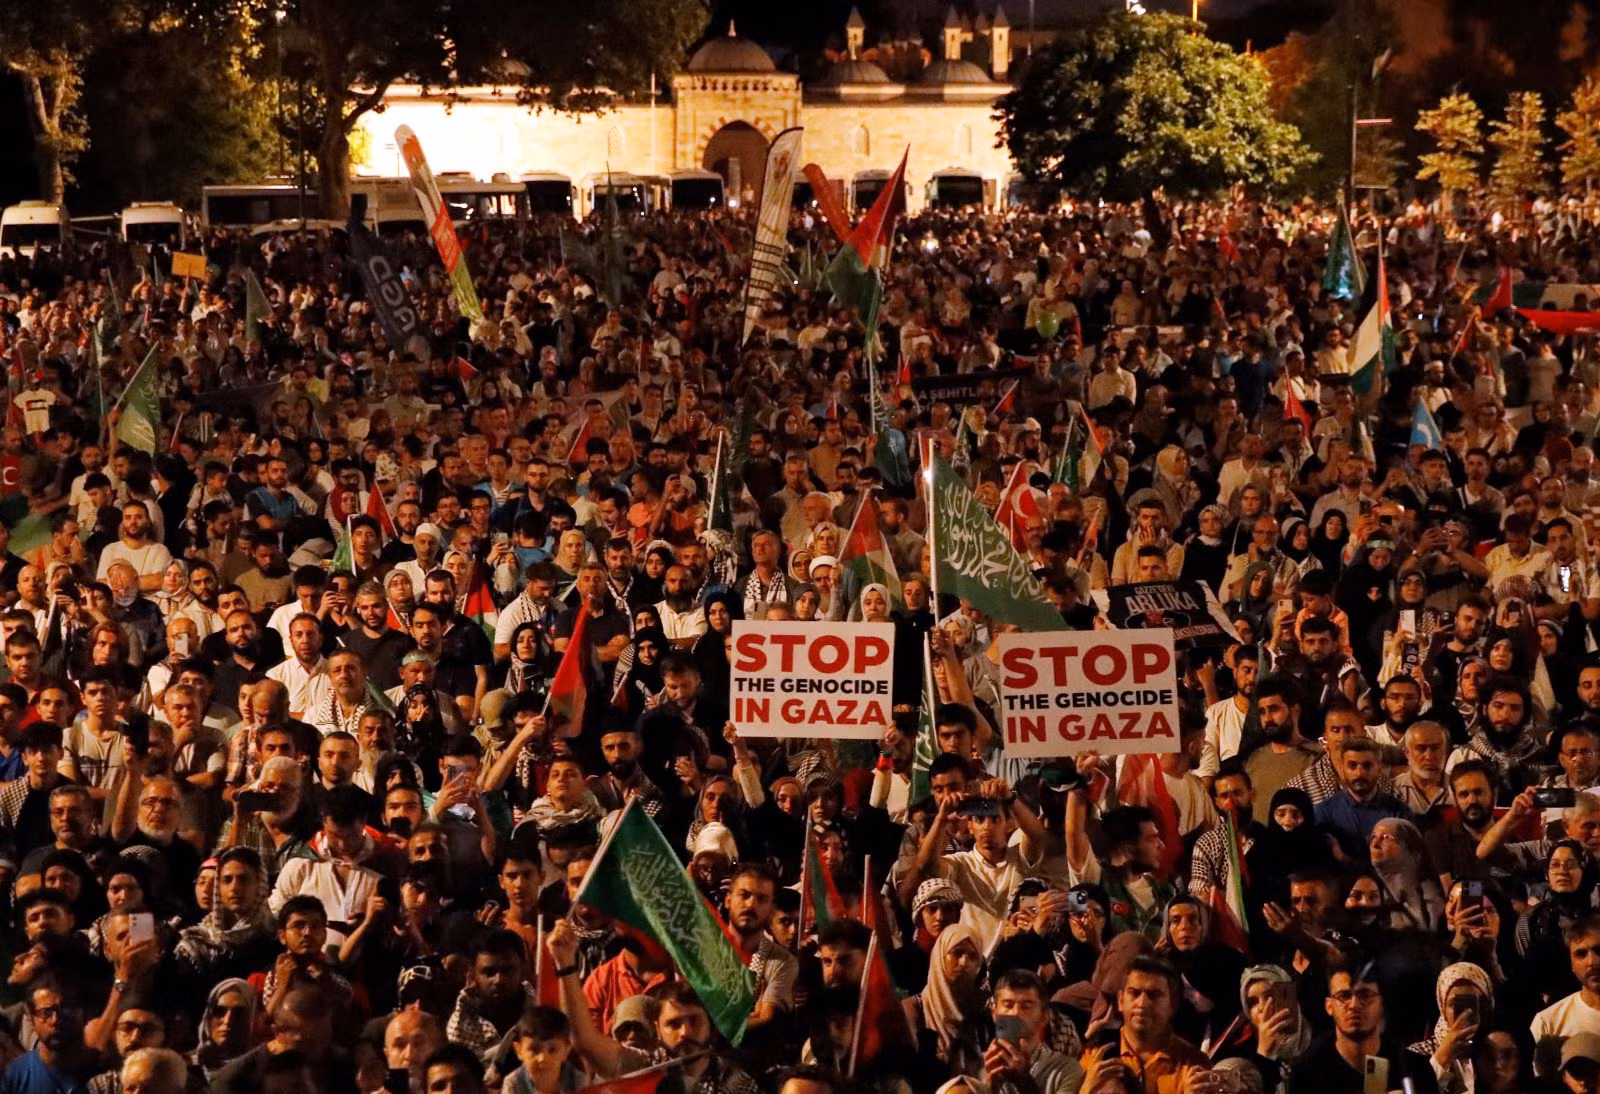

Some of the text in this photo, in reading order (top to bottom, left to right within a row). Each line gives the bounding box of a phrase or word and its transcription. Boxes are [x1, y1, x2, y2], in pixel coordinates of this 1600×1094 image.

[1125, 592, 1200, 616] ABLUKA
[734, 633, 890, 674] STOP
[1002, 643, 1171, 689] STOP
[734, 677, 889, 695] THE GENOCIDE
[1004, 689, 1173, 710] THE GENOCIDE
[735, 697, 887, 726] IN GAZA
[1006, 711, 1175, 744] IN GAZA
